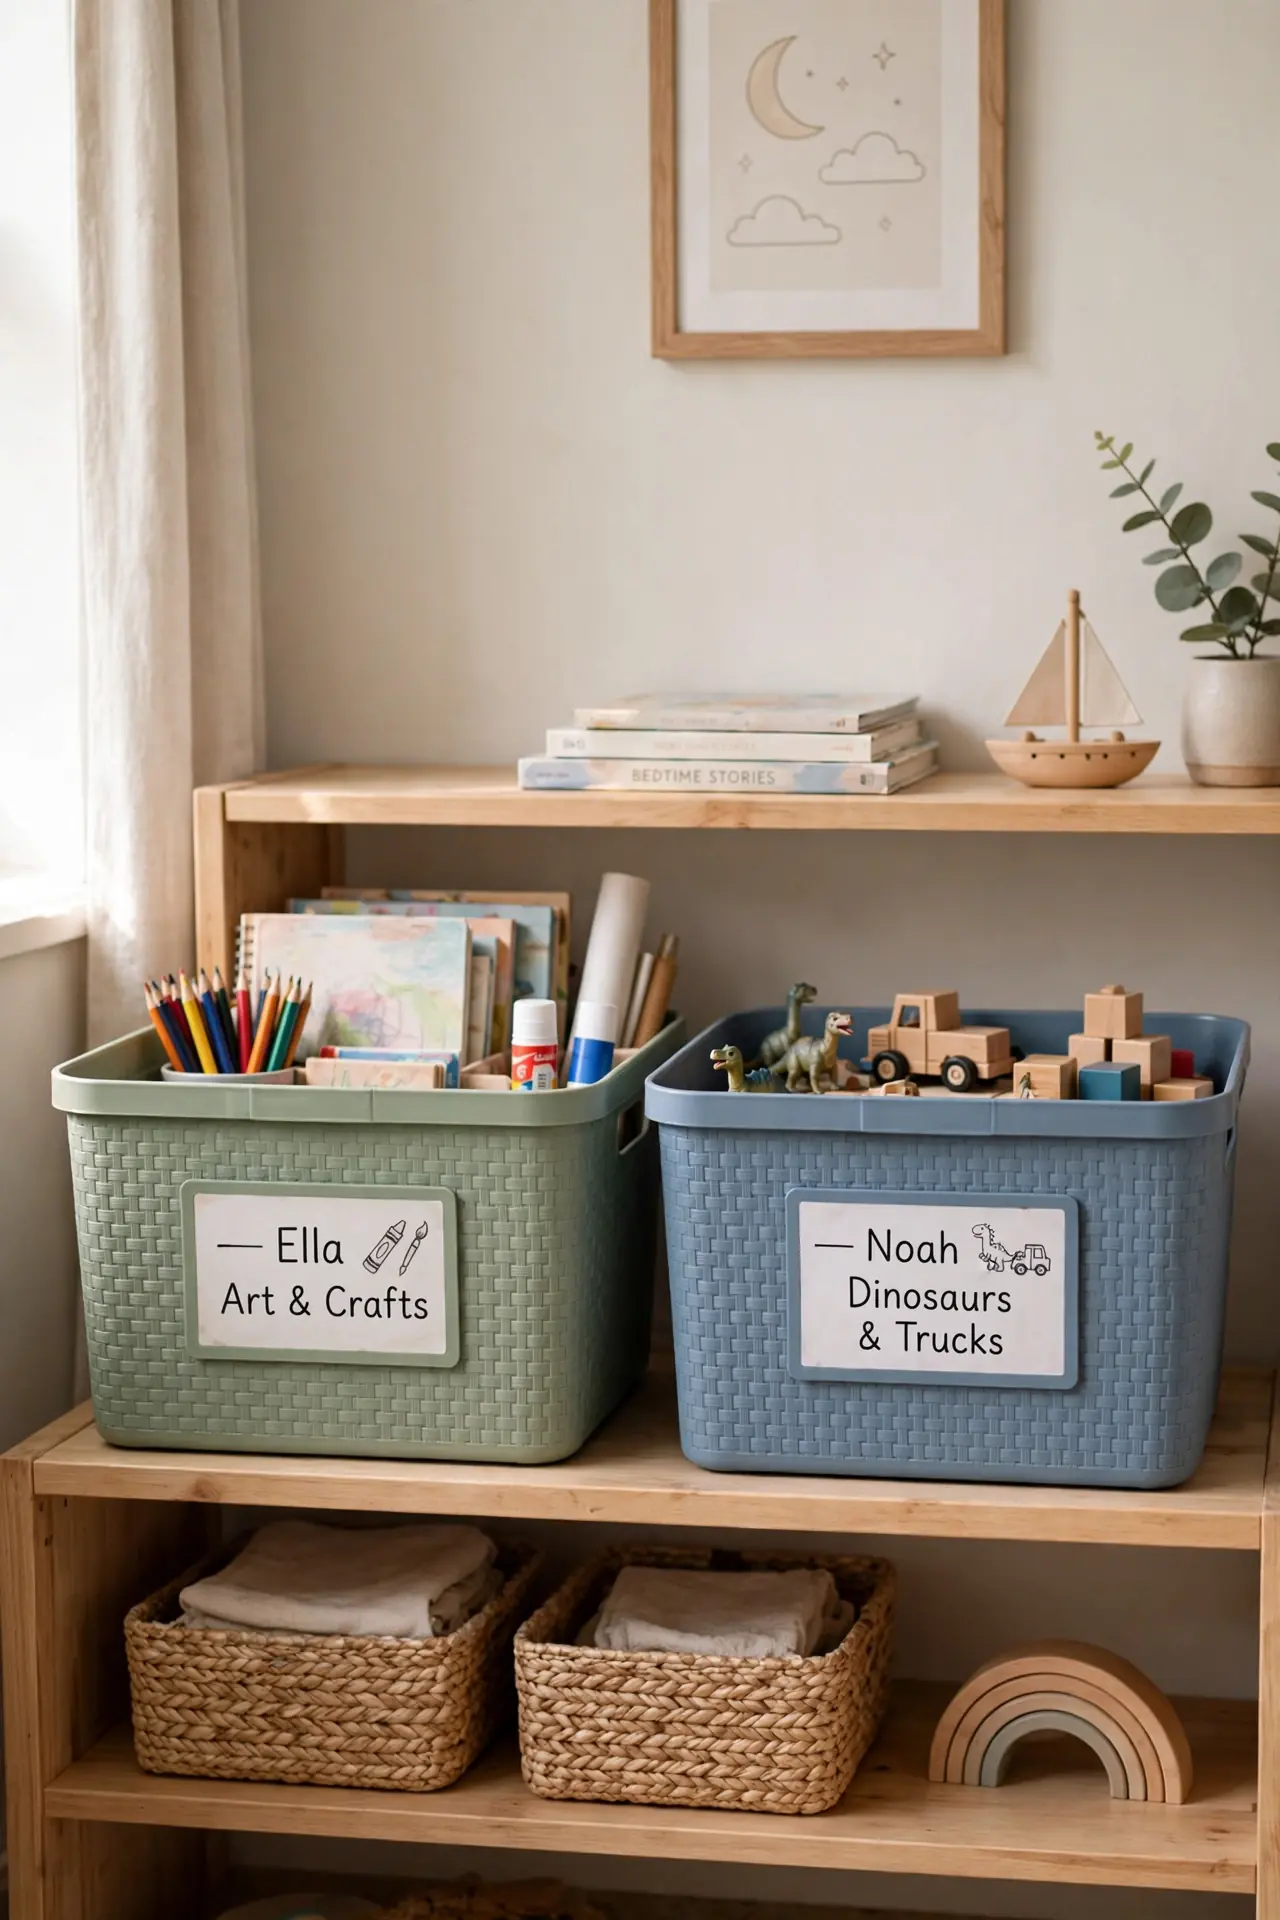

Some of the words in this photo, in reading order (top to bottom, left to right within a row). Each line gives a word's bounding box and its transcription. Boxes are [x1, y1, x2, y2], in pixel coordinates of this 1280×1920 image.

[632, 768, 701, 784] BEDTIME
[709, 769, 776, 785] STORIES
[278, 1227, 344, 1264] Ella
[868, 1228, 958, 1264] Noah
[221, 1283, 275, 1316] Art
[289, 1285, 311, 1316] &
[326, 1285, 428, 1320] Crafts
[850, 1276, 1012, 1313] Dinosaurs
[860, 1320, 881, 1351] &
[895, 1320, 1004, 1355] Trucks
